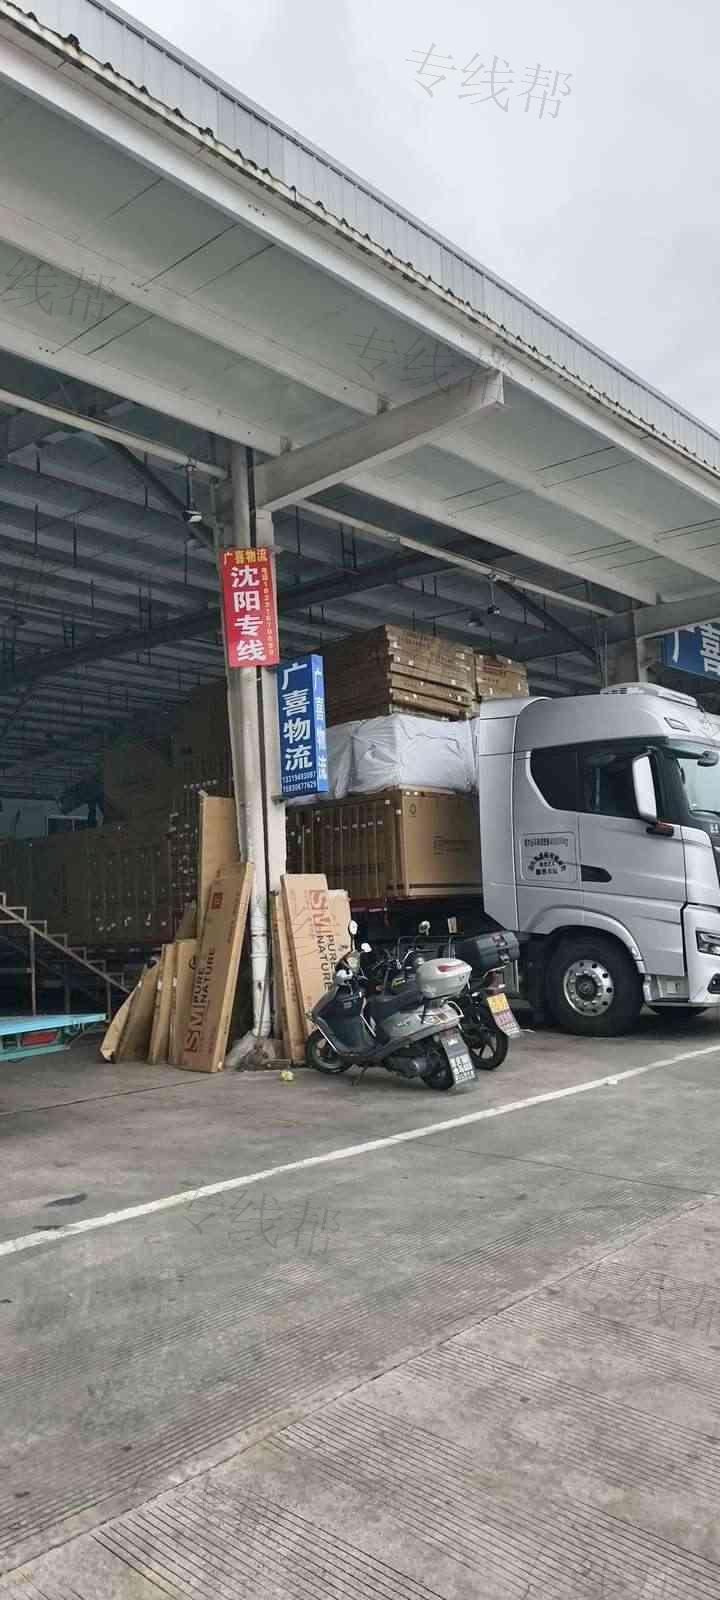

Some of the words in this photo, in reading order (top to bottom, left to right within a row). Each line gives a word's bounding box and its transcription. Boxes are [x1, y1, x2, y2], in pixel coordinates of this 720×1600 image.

[224, 549, 268, 565] 广喜物流
[230, 566, 266, 661] 沈阳专线
[282, 662, 312, 771] 广喜物流
[199, 947, 215, 1004] NATURE
[316, 935, 332, 992] NATURE
[326, 934, 337, 968] PURE
[193, 967, 205, 1004] PURE
